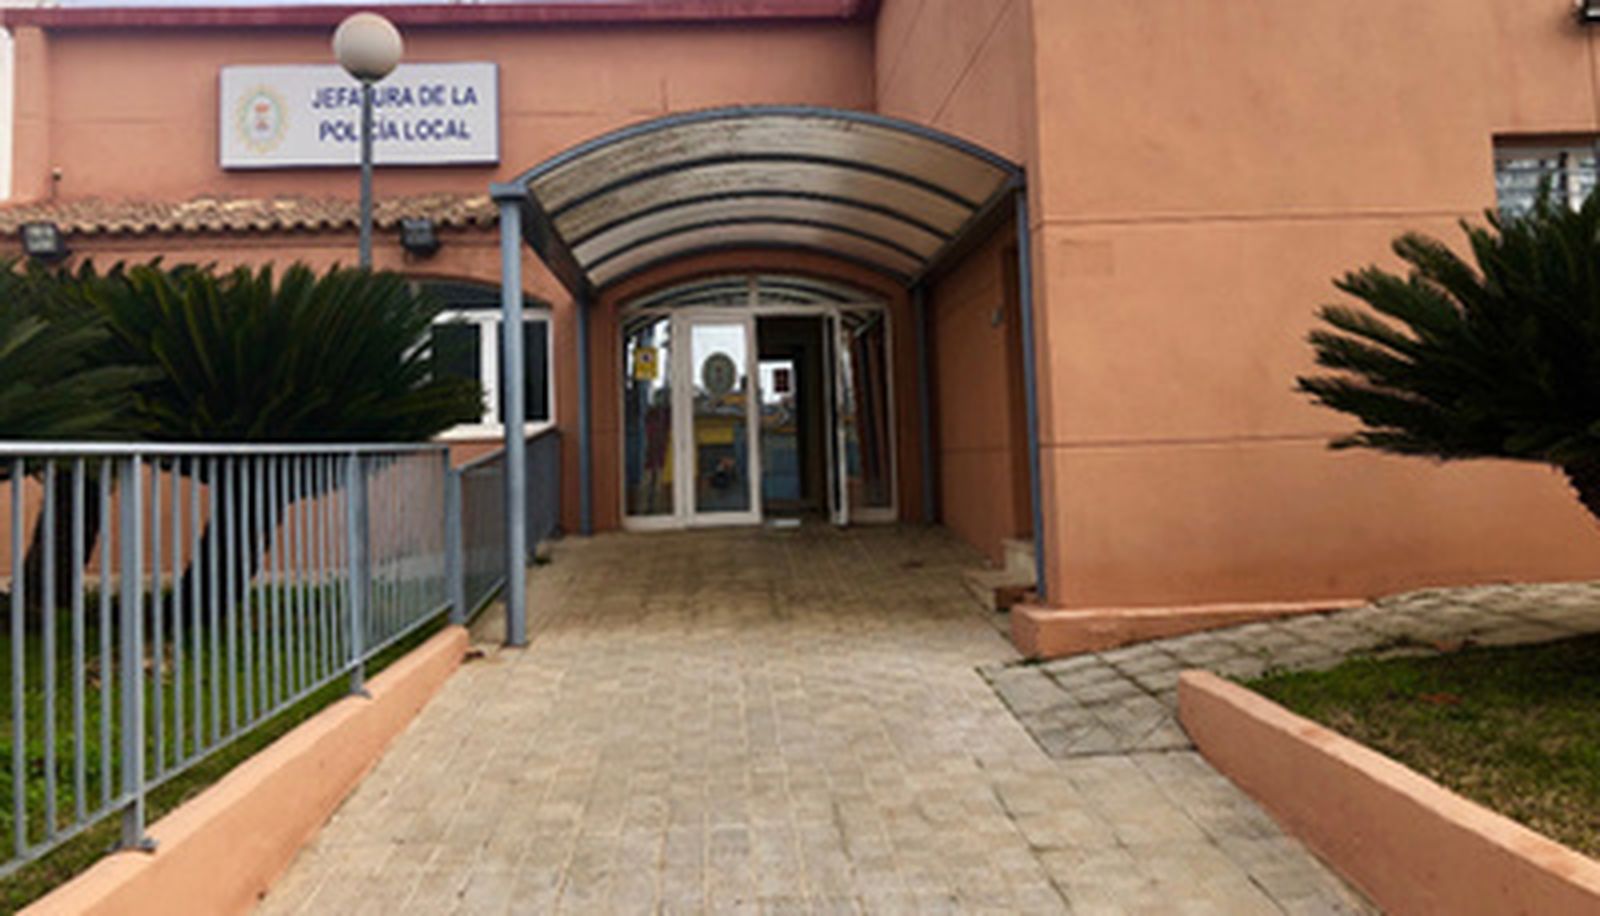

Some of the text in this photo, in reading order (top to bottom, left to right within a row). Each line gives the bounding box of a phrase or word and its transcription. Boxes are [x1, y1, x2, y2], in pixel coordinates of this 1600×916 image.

[312, 86, 478, 109] JEFAURA DE LA
[320, 118, 470, 142] POLCÍA LOCAL
